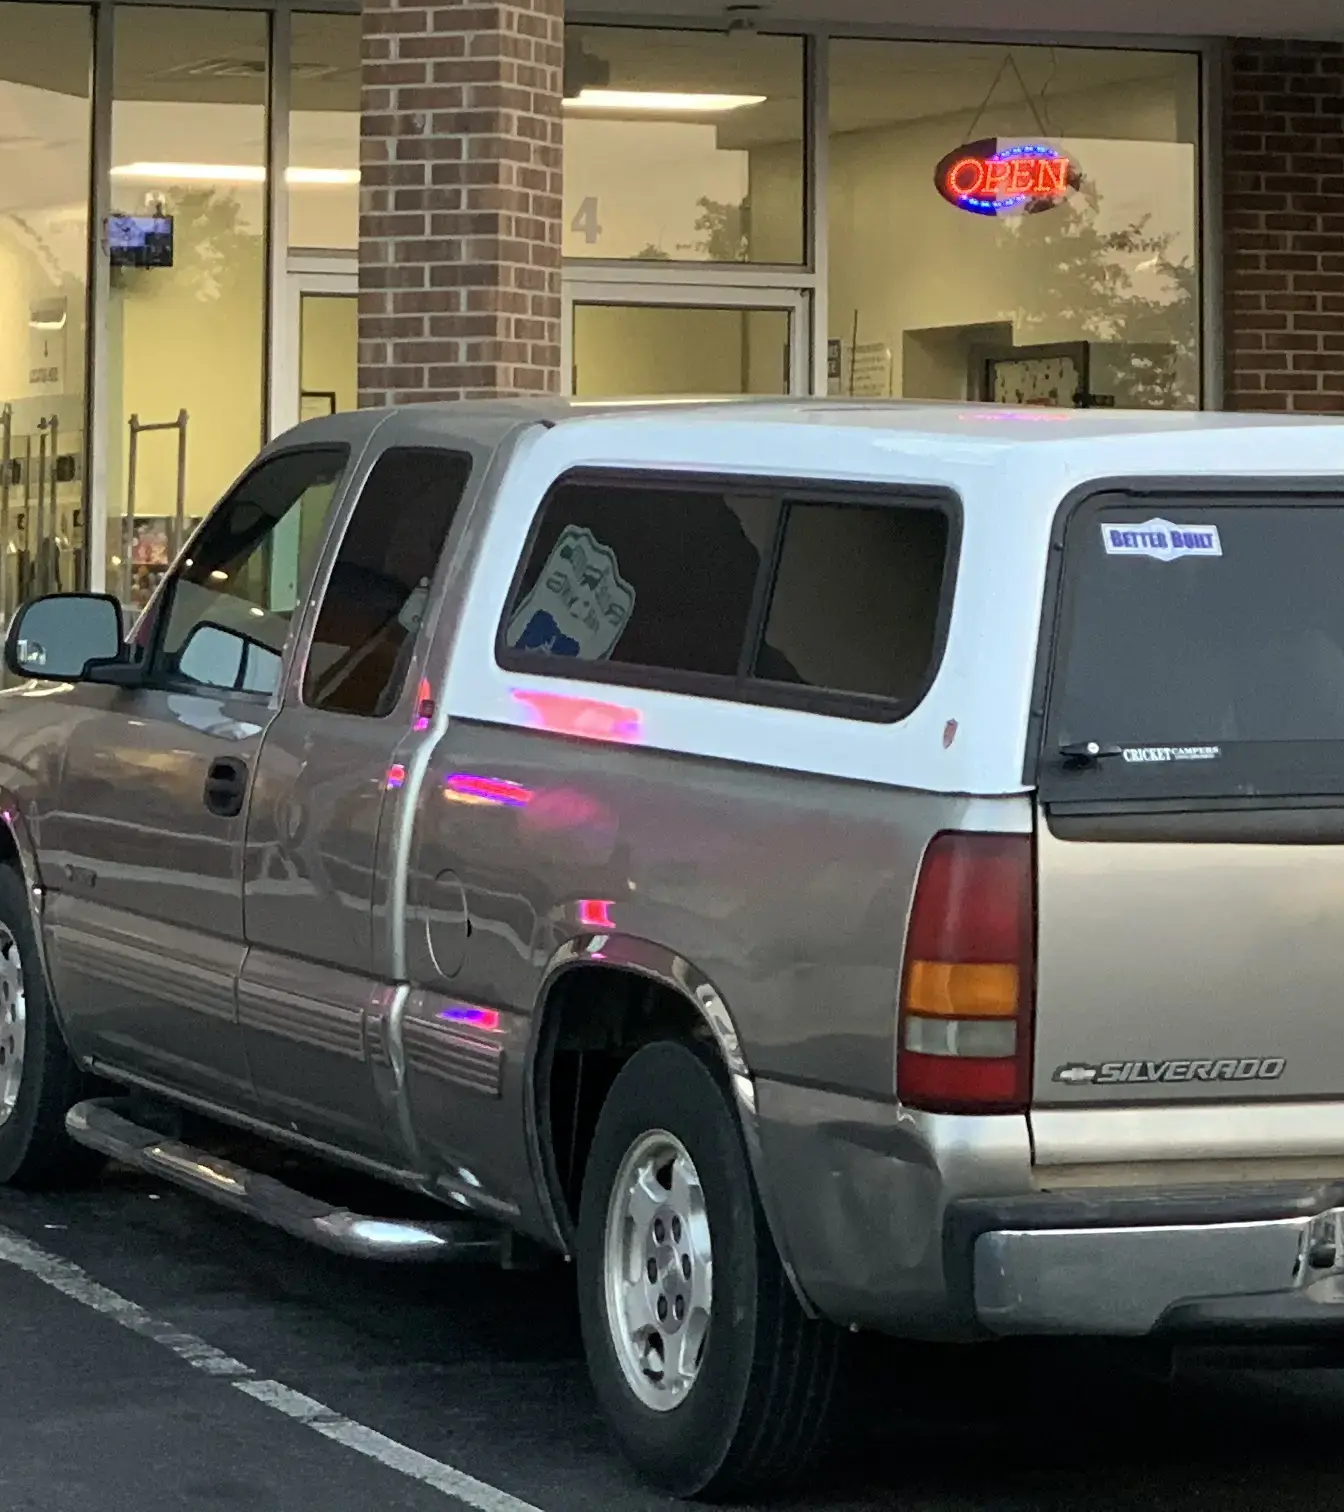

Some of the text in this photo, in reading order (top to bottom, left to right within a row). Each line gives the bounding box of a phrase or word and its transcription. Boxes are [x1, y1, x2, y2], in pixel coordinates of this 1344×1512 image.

[949, 157, 1070, 194] OPEN
[570, 196, 603, 244] 4
[1109, 530, 1213, 549] BETTER BUILT
[1122, 748, 1172, 762] CRICKET
[1094, 1058, 1286, 1084] SILVERADO
